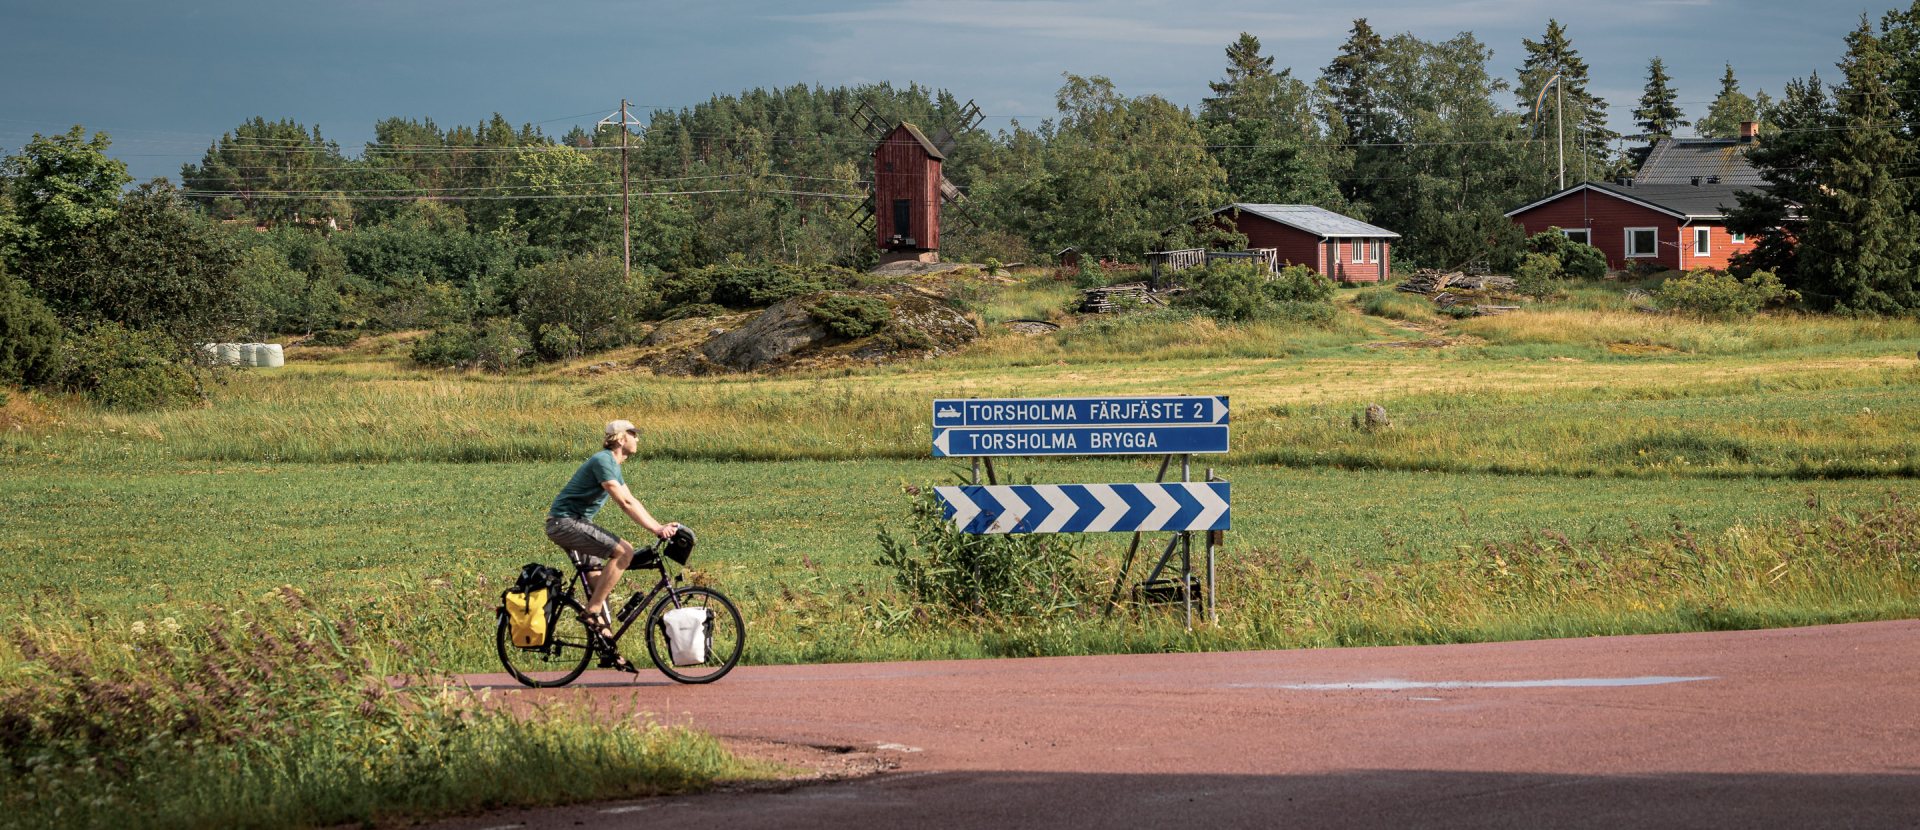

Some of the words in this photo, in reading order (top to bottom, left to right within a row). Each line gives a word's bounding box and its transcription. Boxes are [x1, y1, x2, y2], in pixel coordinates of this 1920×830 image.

[970, 404, 1077, 421] TORSHOLMA
[1090, 400, 1184, 420] FÄRJFÄSTE
[1193, 402, 1203, 419] 2
[969, 433, 1077, 450] TORSHOLMA
[1090, 432, 1158, 449] BRYGGA
